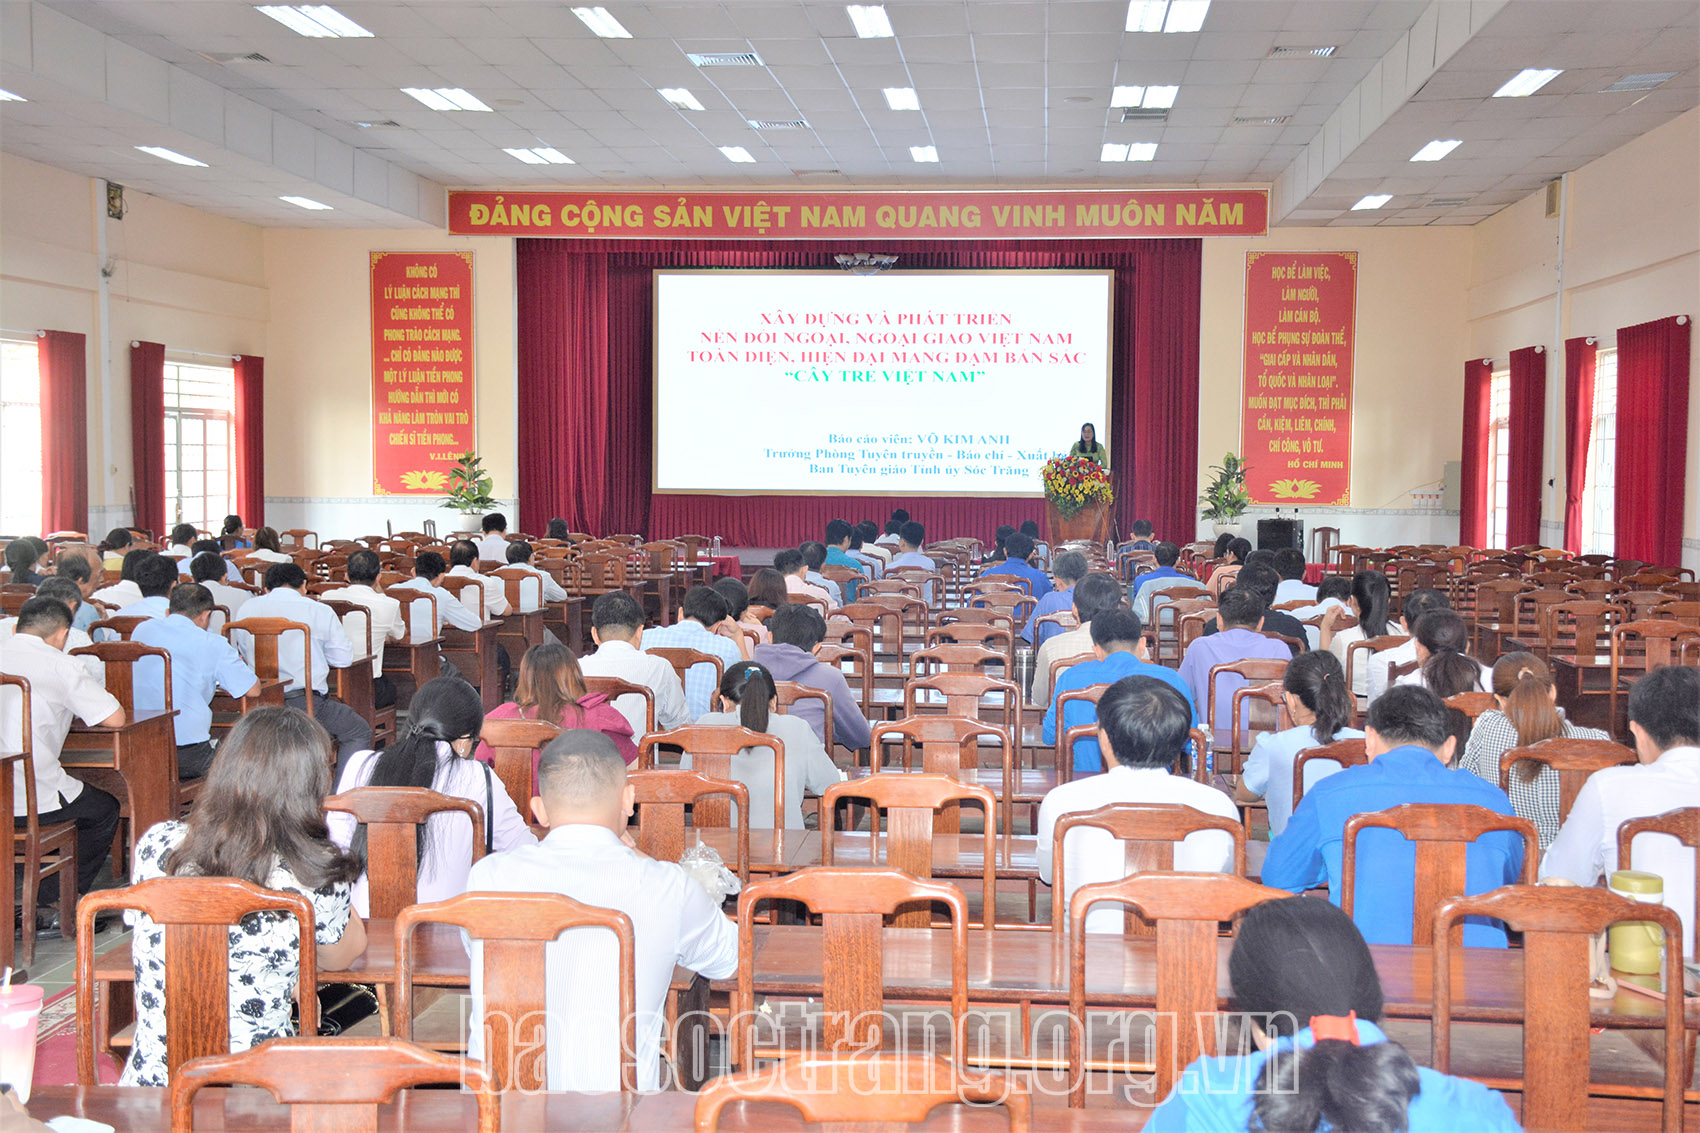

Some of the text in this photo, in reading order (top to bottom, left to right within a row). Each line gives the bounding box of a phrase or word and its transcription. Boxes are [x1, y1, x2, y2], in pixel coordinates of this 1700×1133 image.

[470, 196, 1244, 234] ĐẢNG CỘNG SẢN VIỆT NAM QUANG VINH MUÔN NĂM
